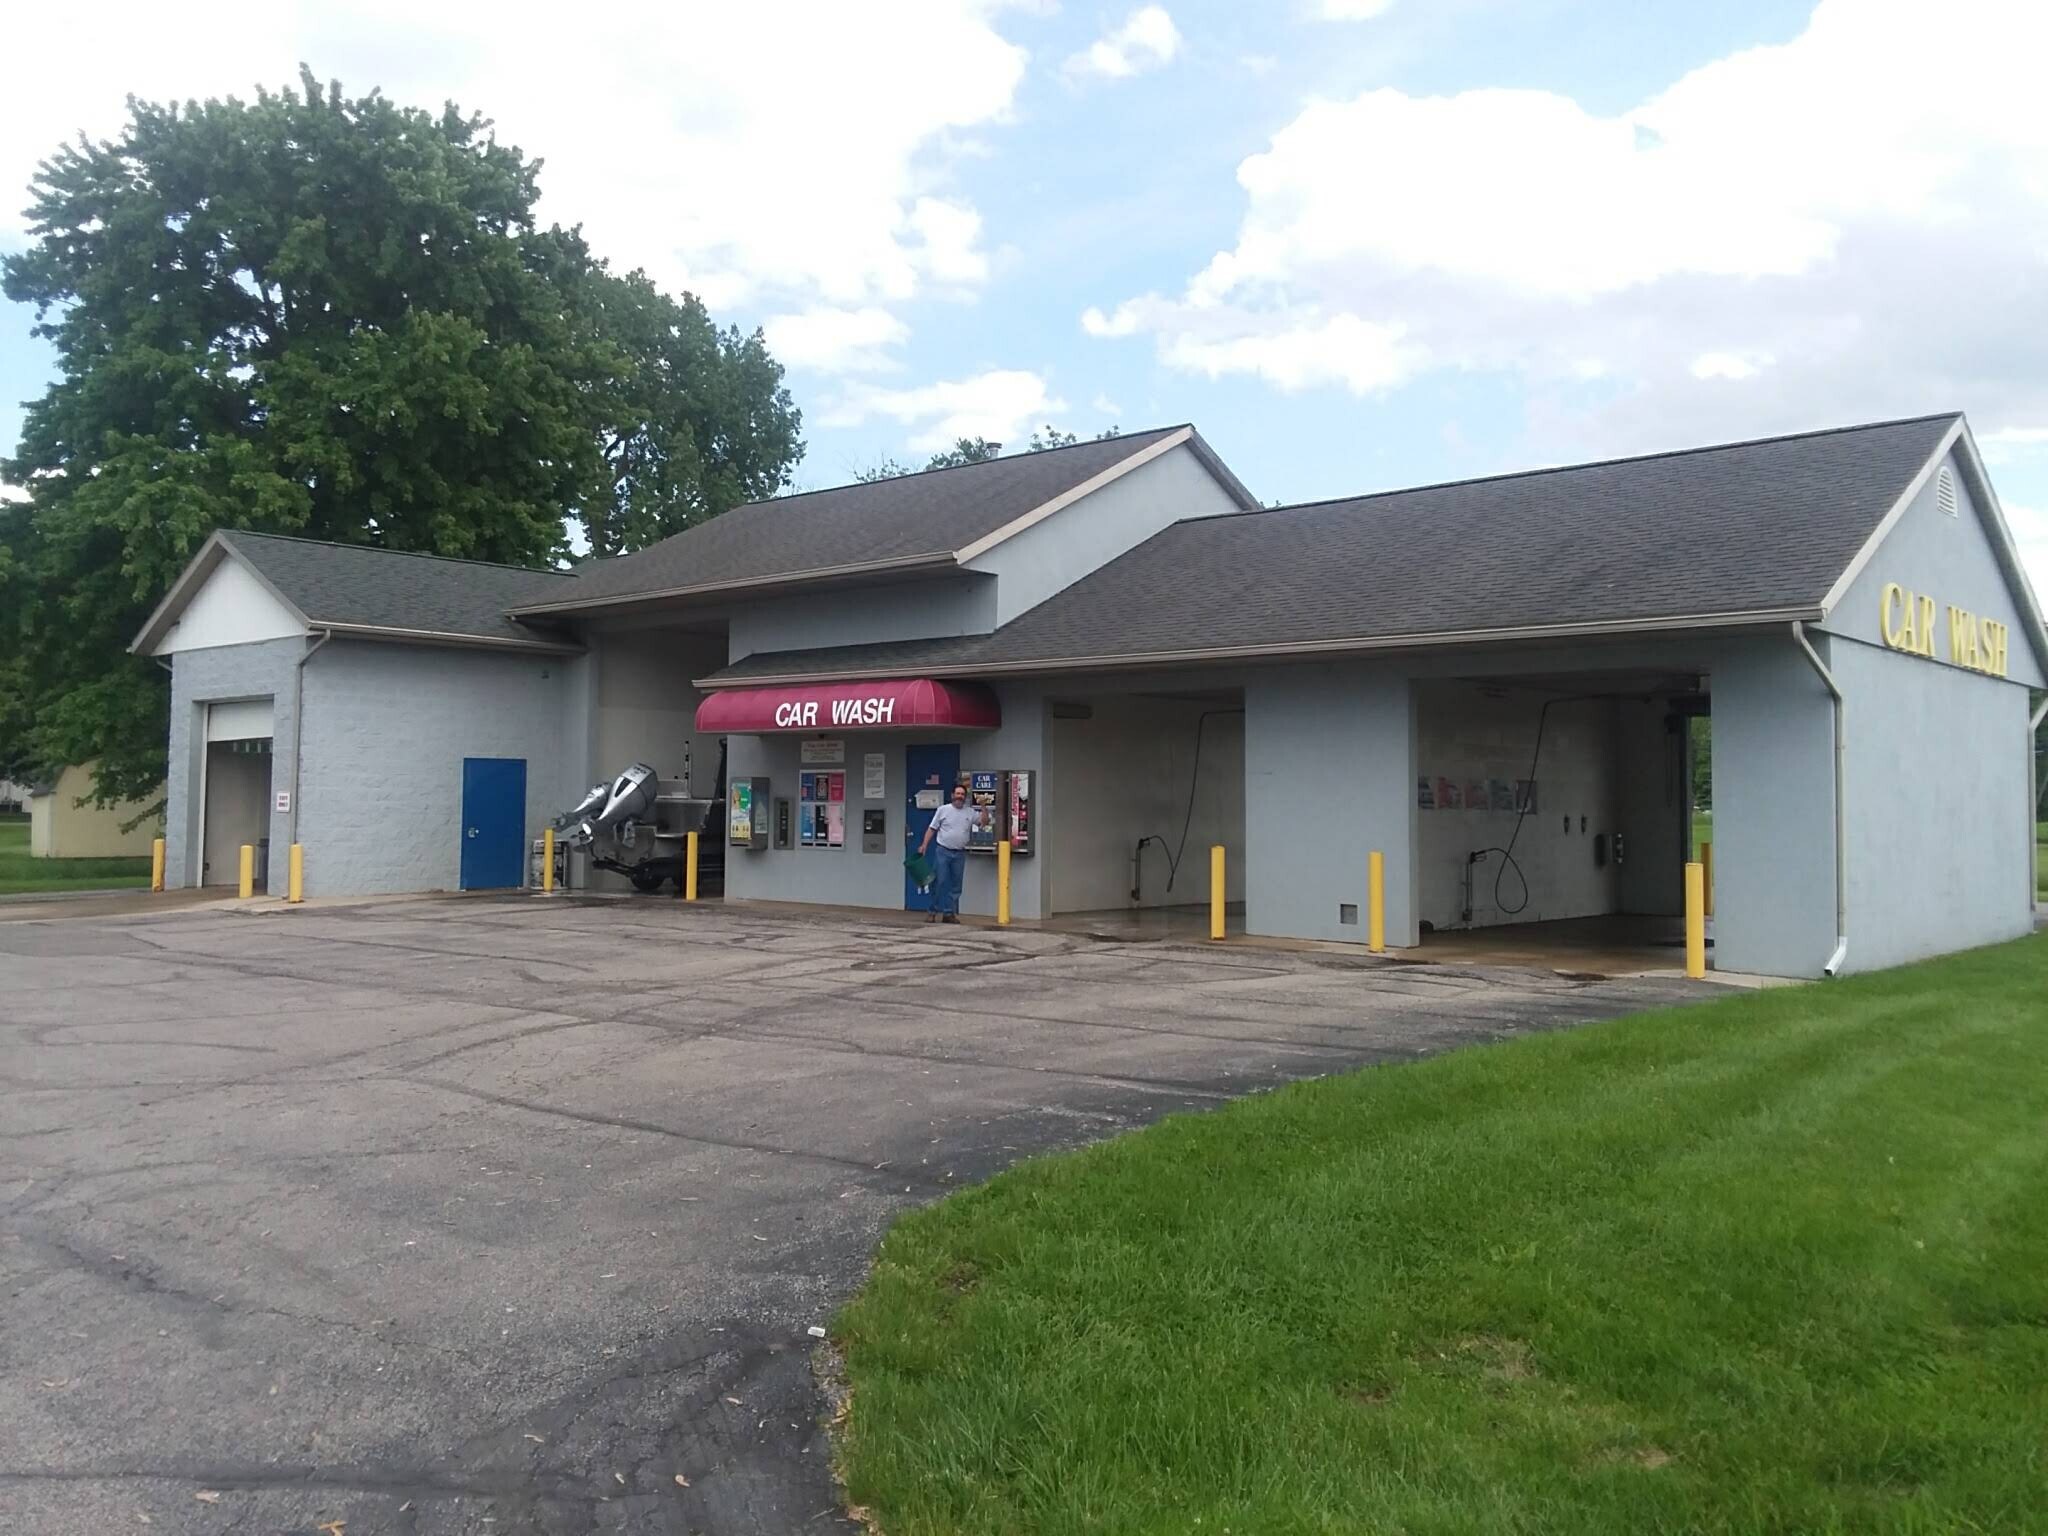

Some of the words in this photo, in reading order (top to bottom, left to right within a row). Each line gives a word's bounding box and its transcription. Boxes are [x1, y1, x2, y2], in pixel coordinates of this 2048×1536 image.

[1880, 582, 1937, 659] CAR
[1947, 604, 2009, 678] WASH
[775, 701, 819, 727] CAR
[832, 697, 895, 725] WASH
[975, 781, 992, 789] CARE
